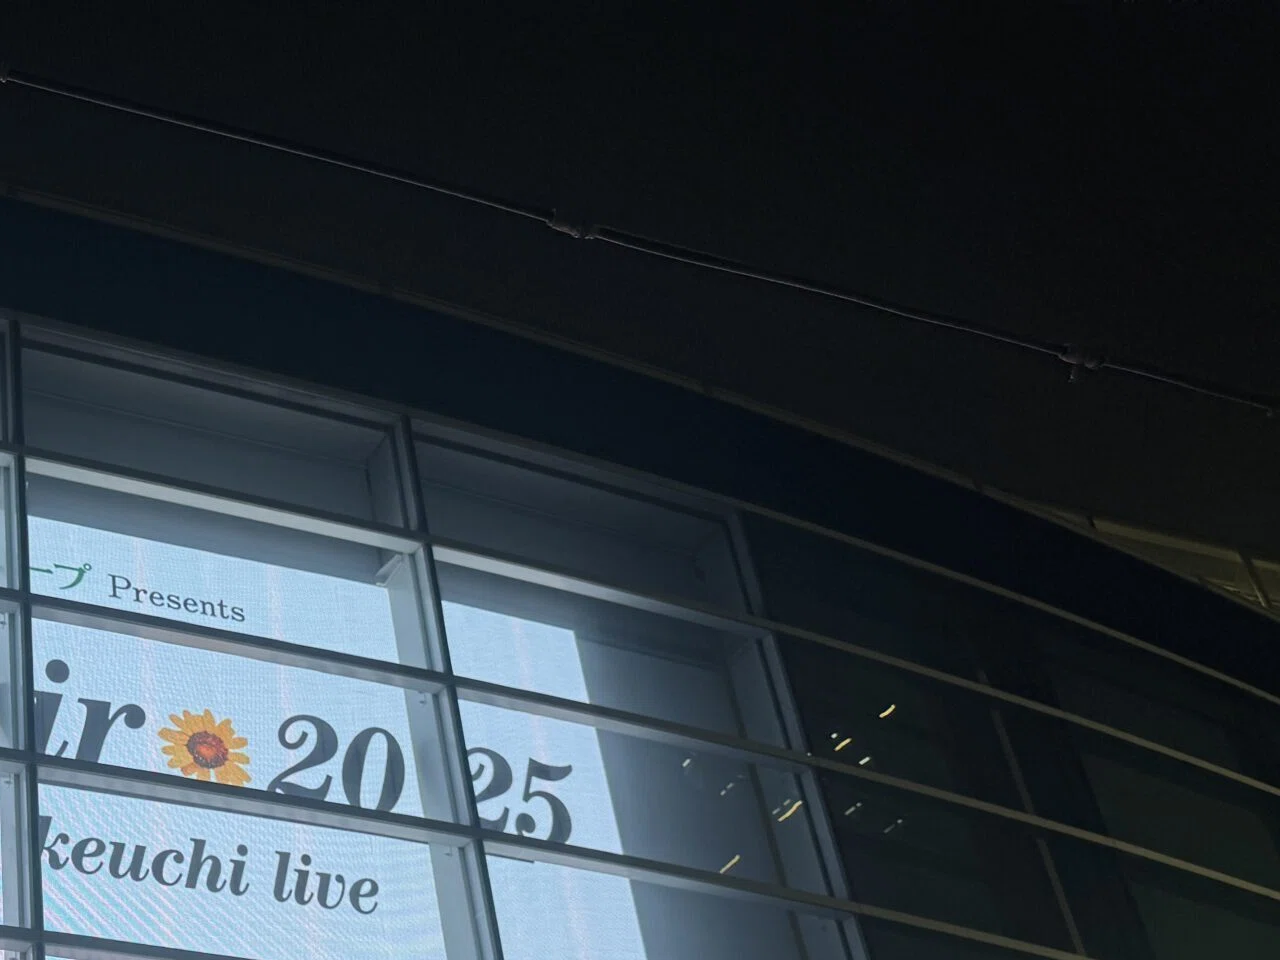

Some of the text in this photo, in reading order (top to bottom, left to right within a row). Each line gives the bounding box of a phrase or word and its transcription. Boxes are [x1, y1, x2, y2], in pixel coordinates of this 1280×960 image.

[108, 573, 246, 623] Presents
[267, 713, 574, 845] 2025
[272, 850, 381, 916] live
